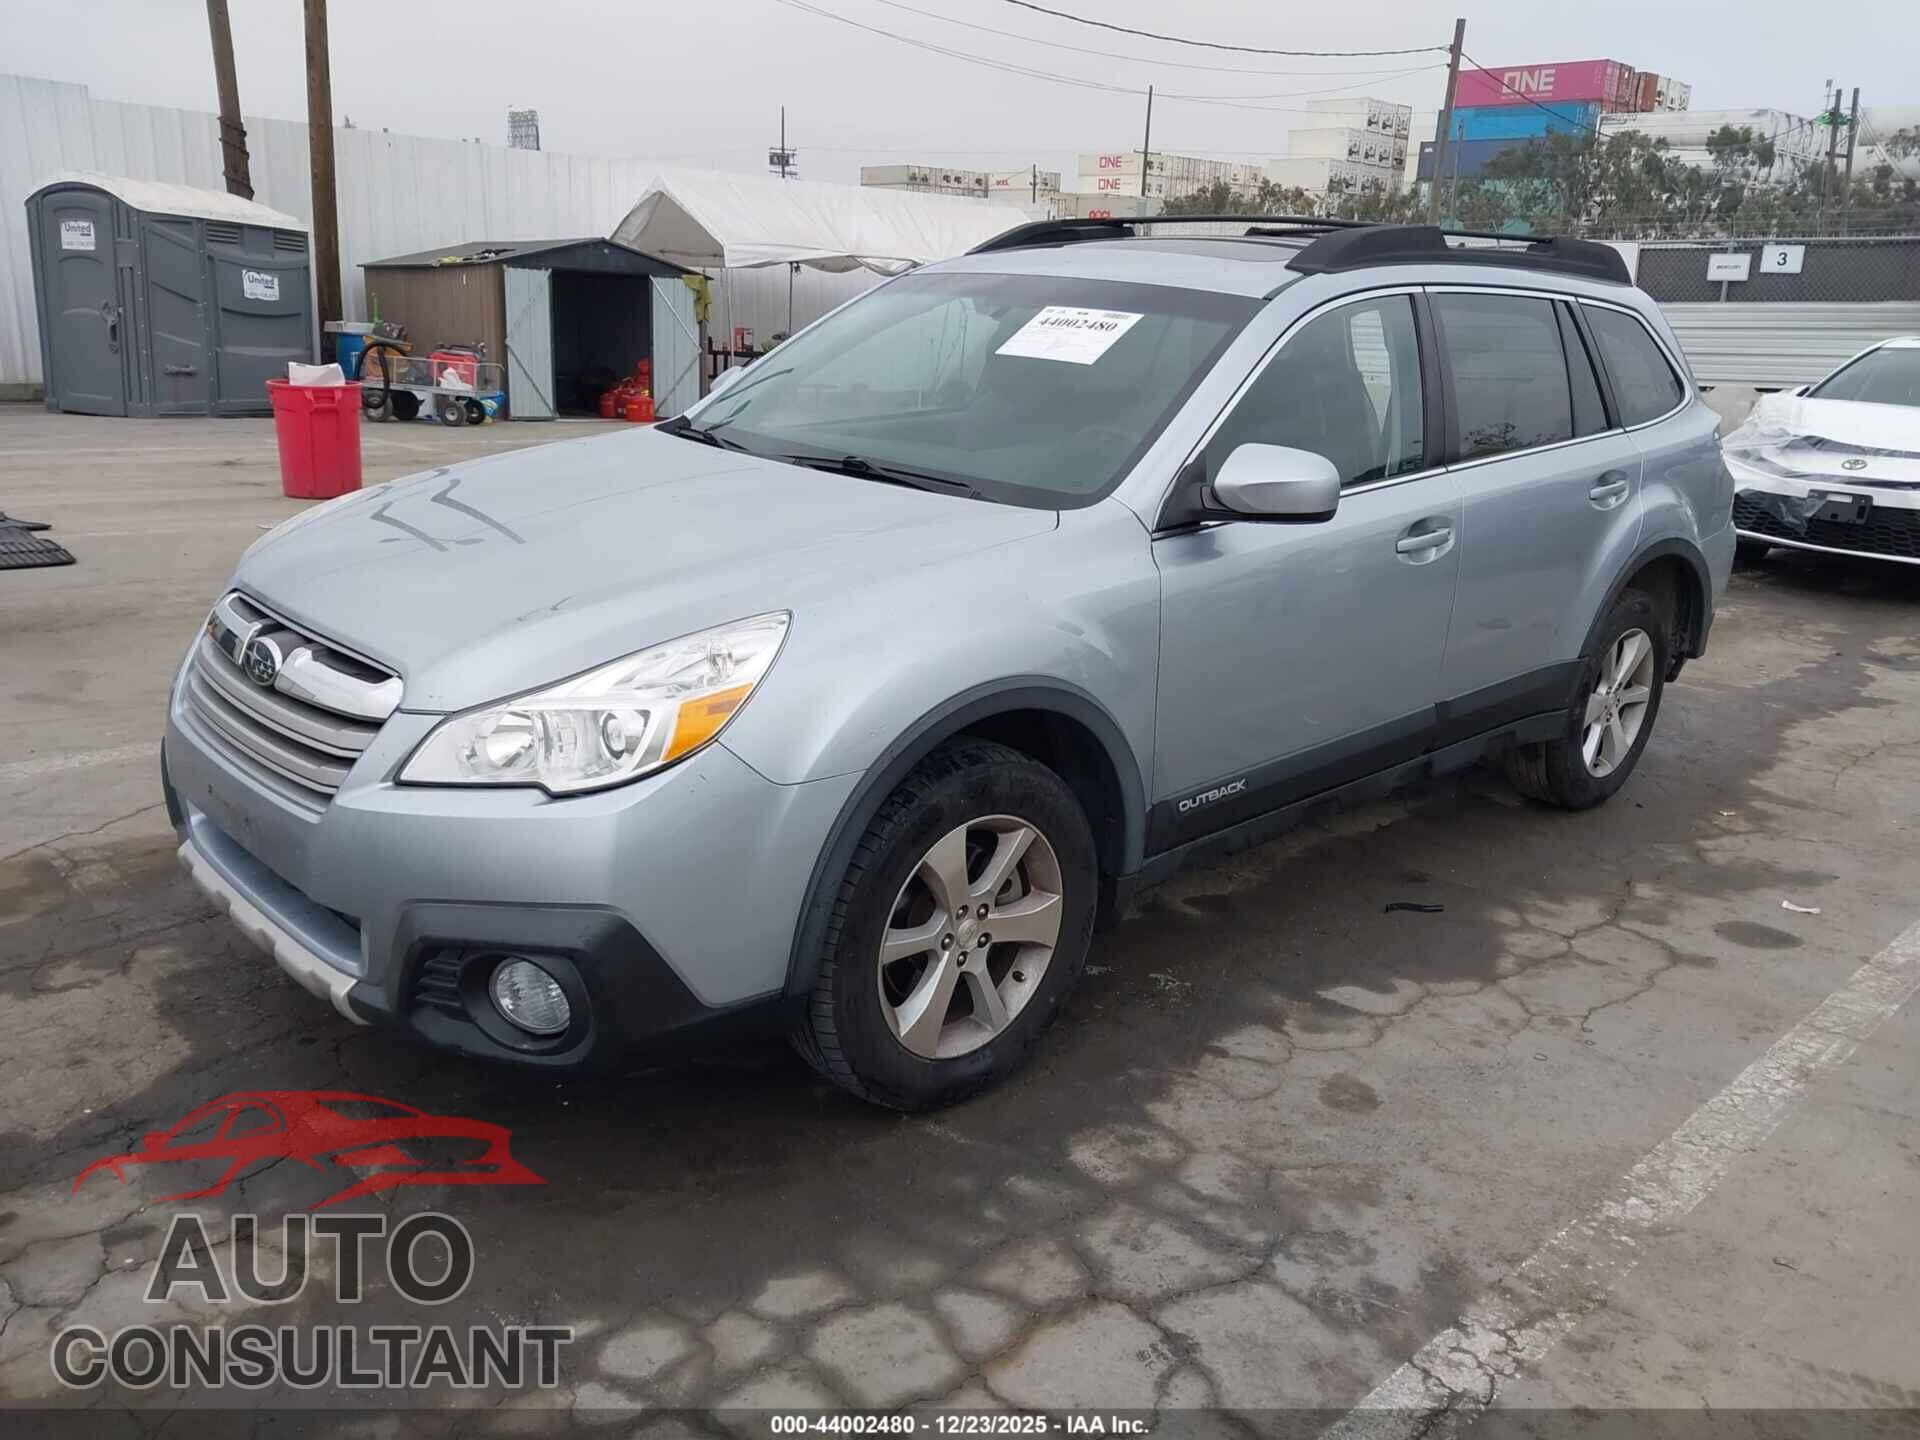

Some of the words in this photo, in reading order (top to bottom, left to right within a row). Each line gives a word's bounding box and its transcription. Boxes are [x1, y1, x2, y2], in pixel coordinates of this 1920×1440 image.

[1502, 69, 1556, 93] ONE
[1099, 156, 1122, 169] ONE
[1098, 178, 1121, 190] ONE
[64, 222, 92, 233] United
[1776, 251, 1788, 266] 3
[247, 273, 275, 287] United
[1039, 316, 1118, 332] 44002480
[1178, 778, 1247, 812] OUTBACK
